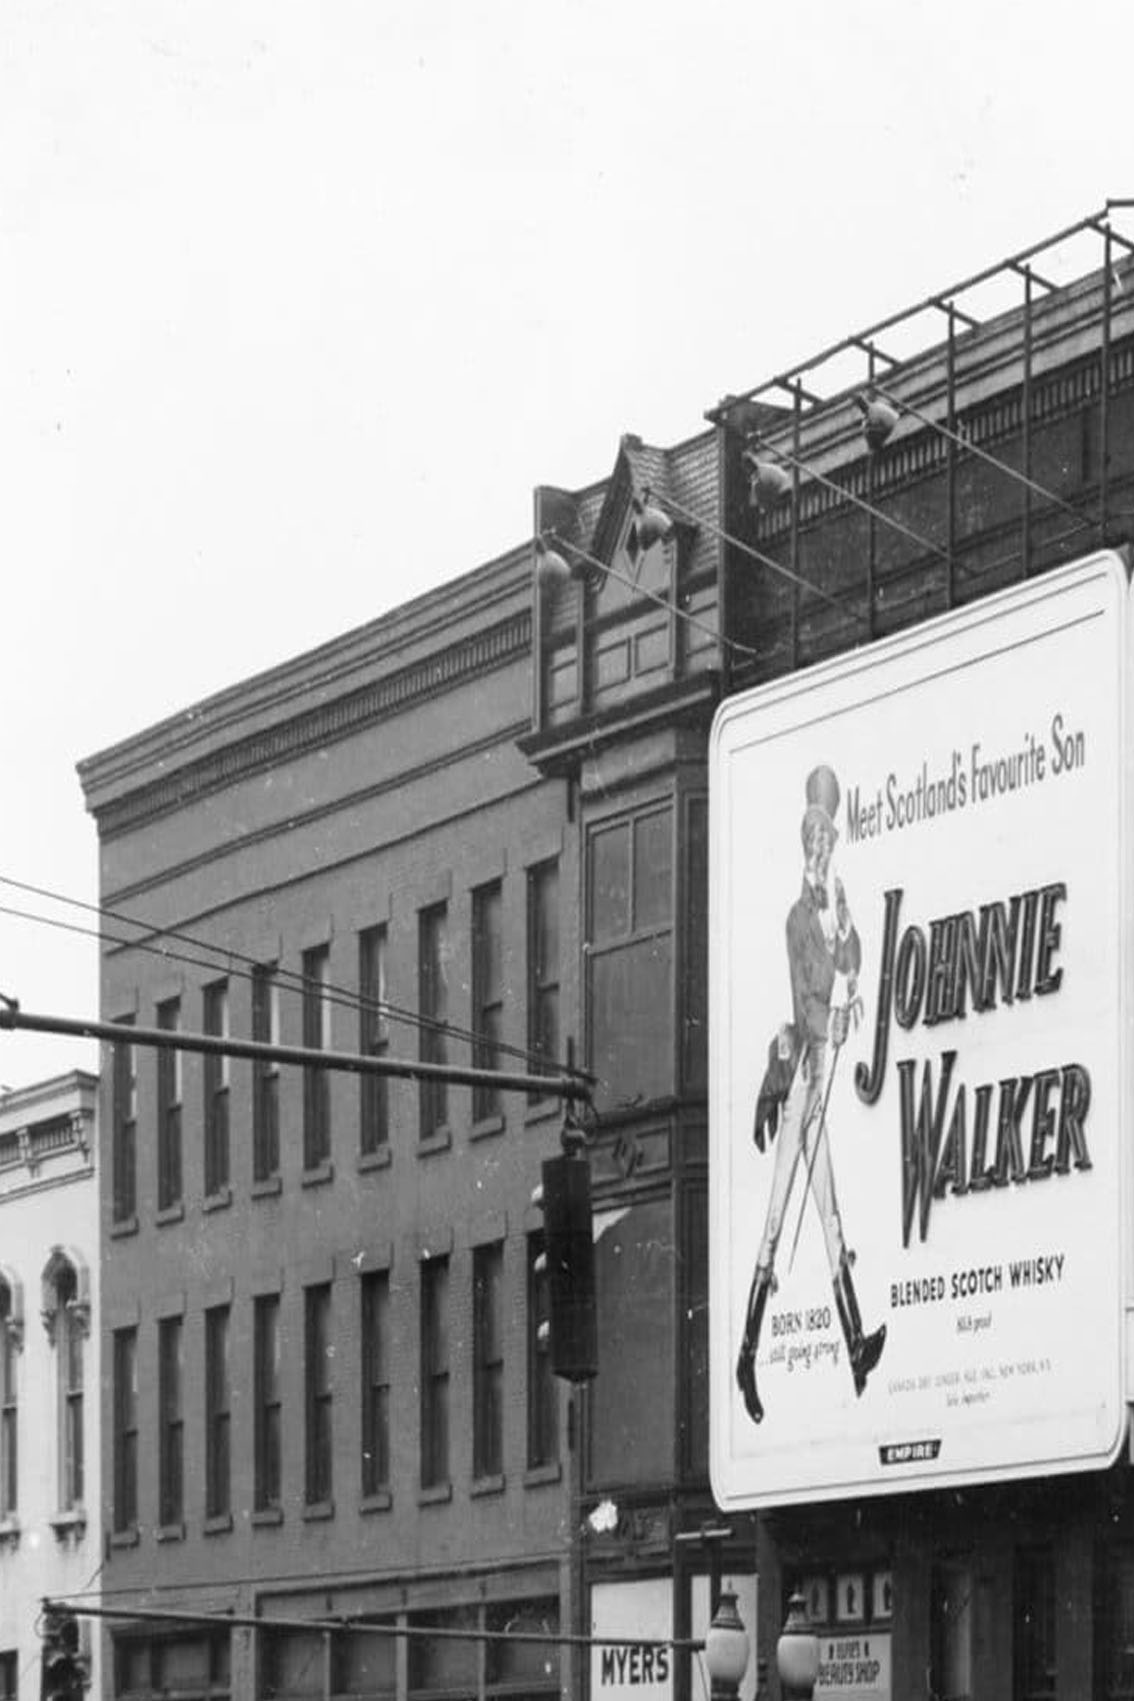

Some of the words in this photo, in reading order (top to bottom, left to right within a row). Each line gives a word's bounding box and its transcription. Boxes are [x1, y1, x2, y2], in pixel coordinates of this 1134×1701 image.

[847, 786, 883, 843] Meet
[886, 749, 967, 831] Scotland's
[972, 732, 1046, 804] Favourite
[1051, 712, 1085, 776] Son
[855, 882, 1067, 1106] JOHNNIE
[897, 1049, 1093, 1249] WALKER
[890, 1275, 945, 1309] BLENDED
[951, 1264, 1003, 1300] SCOTCH
[1008, 1253, 1065, 1288] WHISKY
[772, 1311, 802, 1337] BORN
[806, 1305, 831, 1332] 1820
[887, 1444, 933, 1462] EMPIRE
[601, 1646, 669, 1686] MYERS
